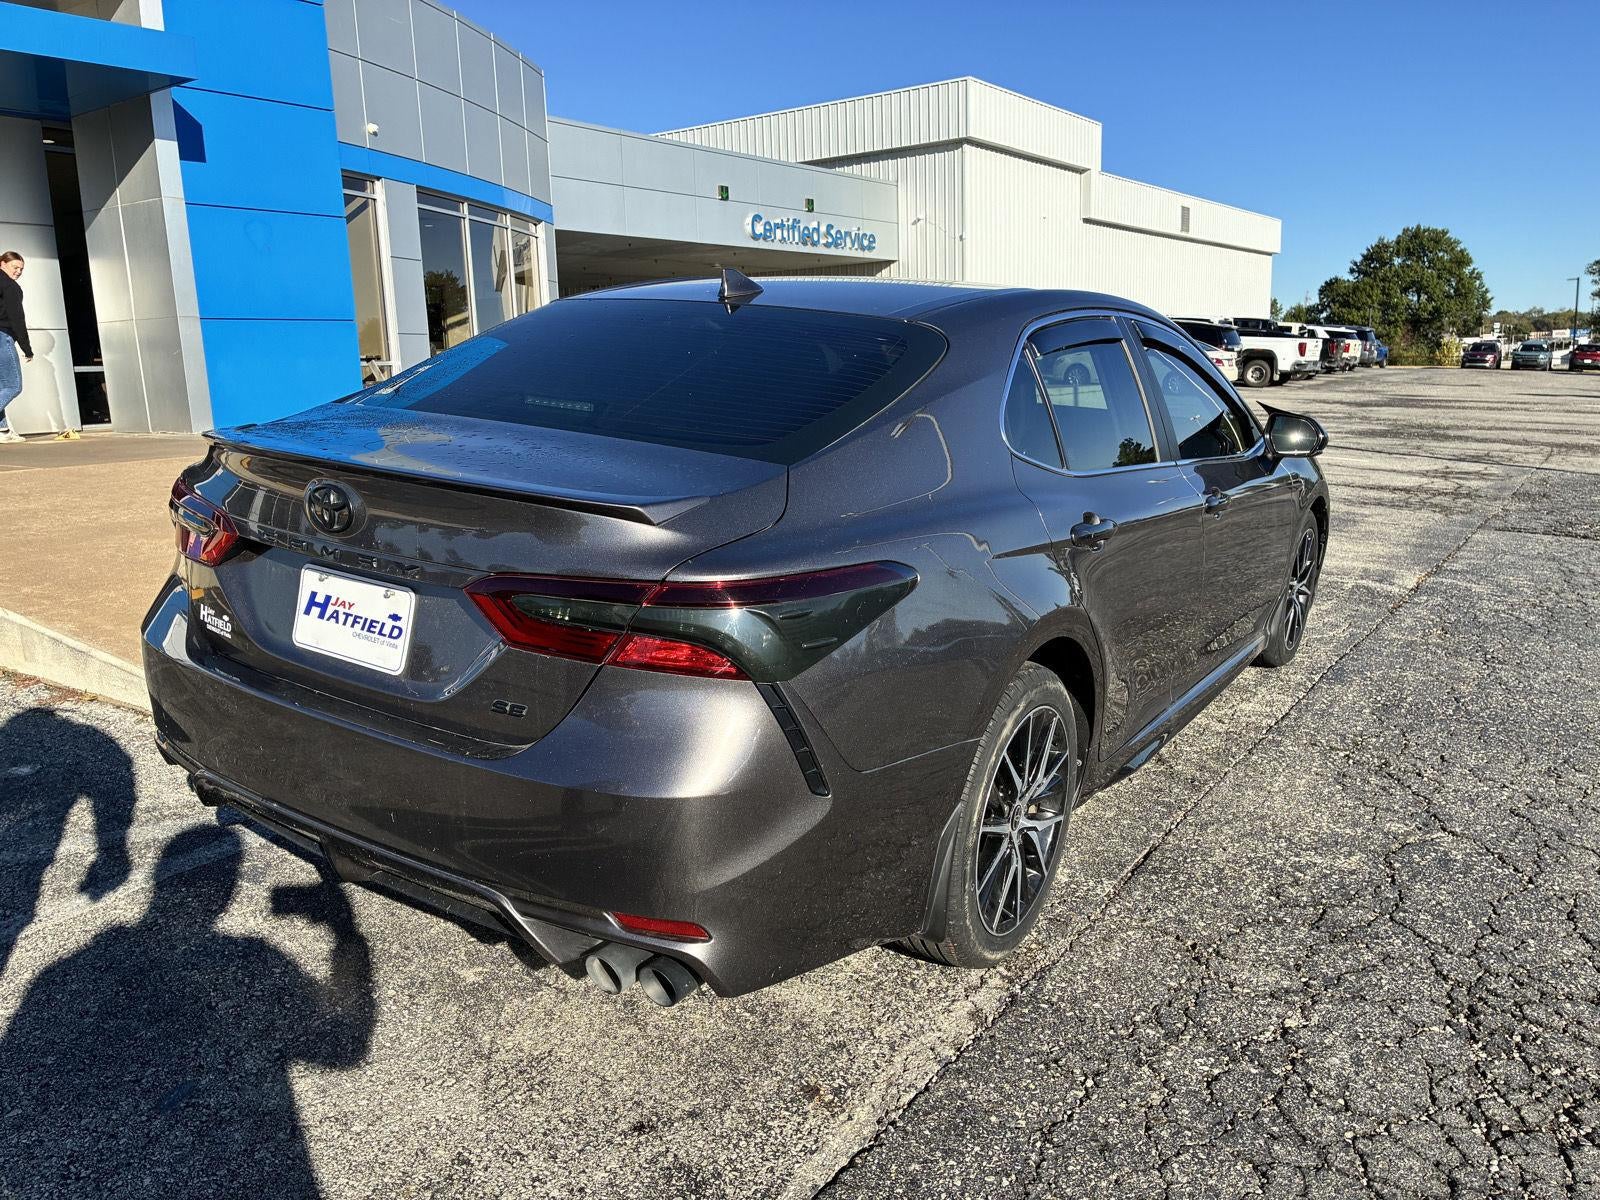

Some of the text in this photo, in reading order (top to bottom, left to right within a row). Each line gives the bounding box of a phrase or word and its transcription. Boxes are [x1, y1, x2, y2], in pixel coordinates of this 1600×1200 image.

[751, 214, 876, 251] Certified Service
[331, 597, 355, 610] JAY
[200, 603, 232, 632] HATFIELD
[303, 591, 403, 640] HATFIELD
[352, 631, 380, 646] CHEVROLET
[490, 699, 528, 717] SE
